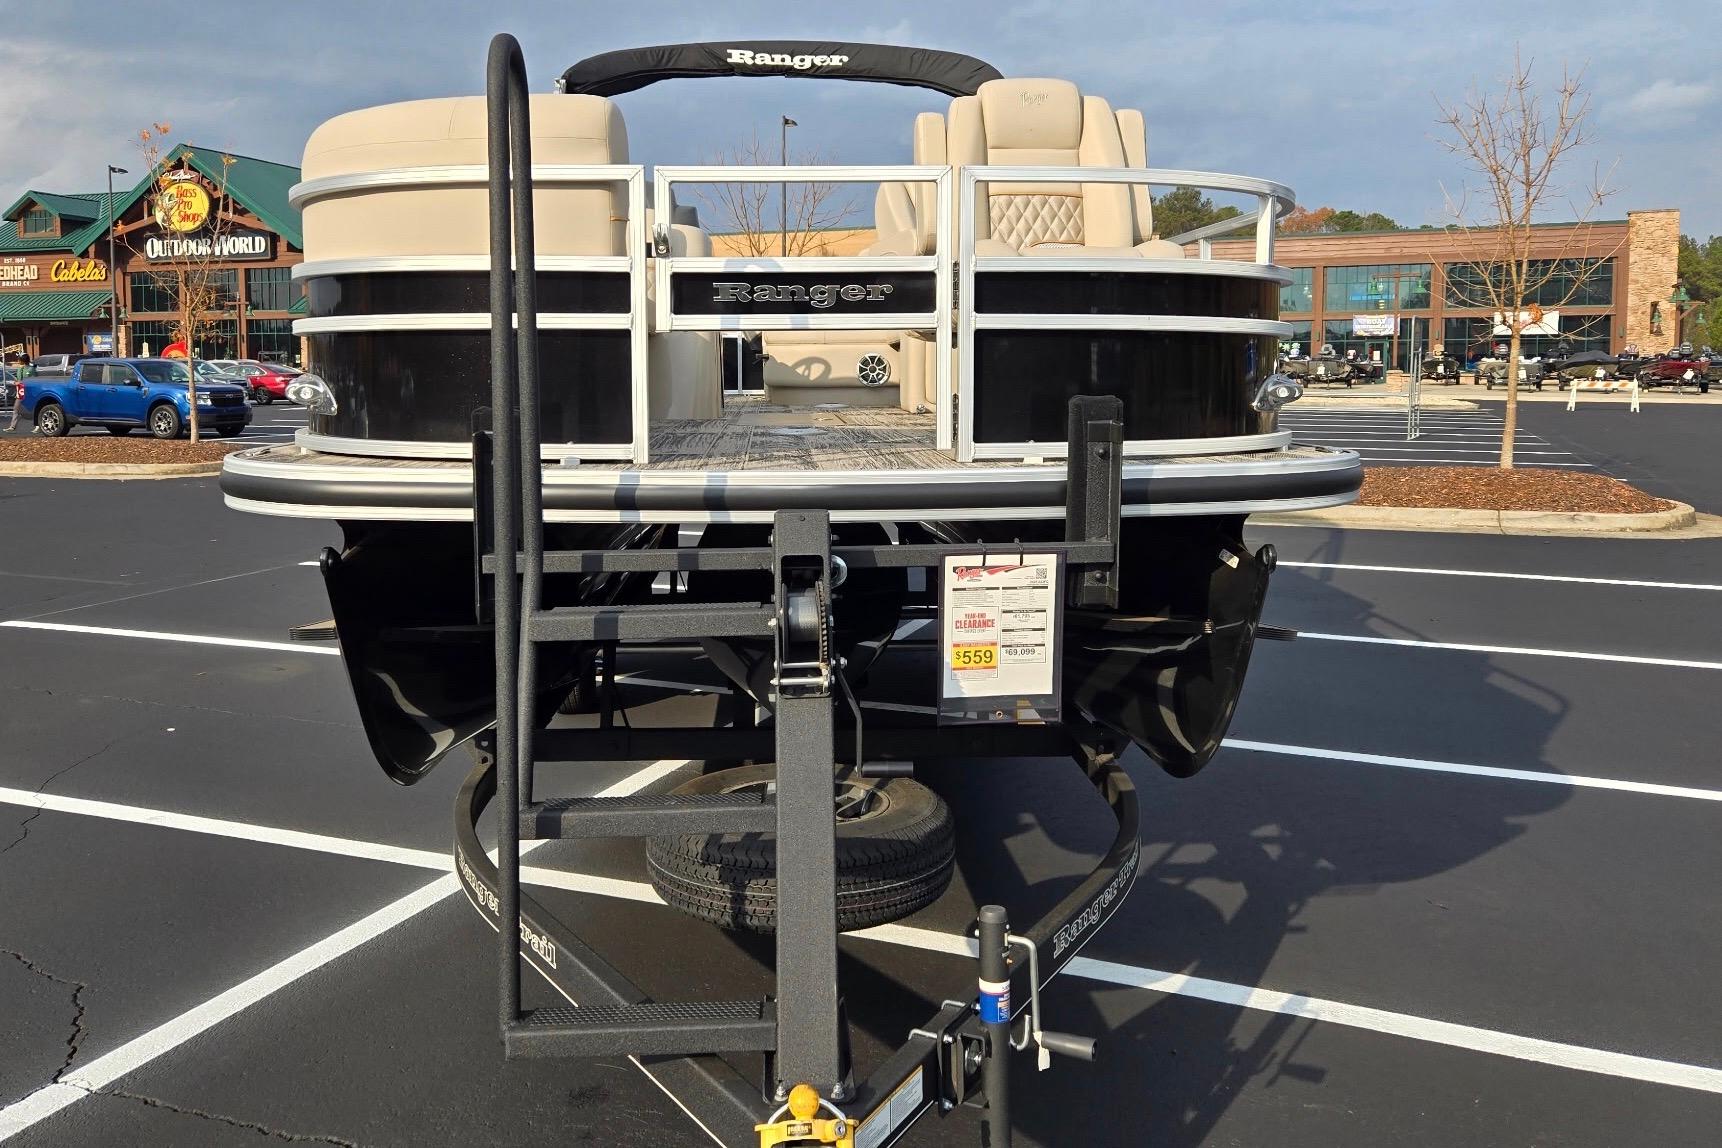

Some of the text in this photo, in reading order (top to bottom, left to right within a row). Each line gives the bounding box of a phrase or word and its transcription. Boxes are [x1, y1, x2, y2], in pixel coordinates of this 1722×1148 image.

[726, 49, 849, 70] Ranger
[175, 186, 197, 198] Bass
[177, 200, 193, 210] Pro
[177, 211, 203, 225] Shops
[0, 264, 38, 280] EDHEAD
[50, 259, 107, 282] Cabela's
[712, 282, 894, 308] Ranger
[955, 619, 996, 629] CLEARANCE
[955, 649, 994, 665] $559
[1005, 648, 1036, 656] $69,099
[1053, 878, 1119, 959] Ranger
[519, 916, 557, 970] rail
